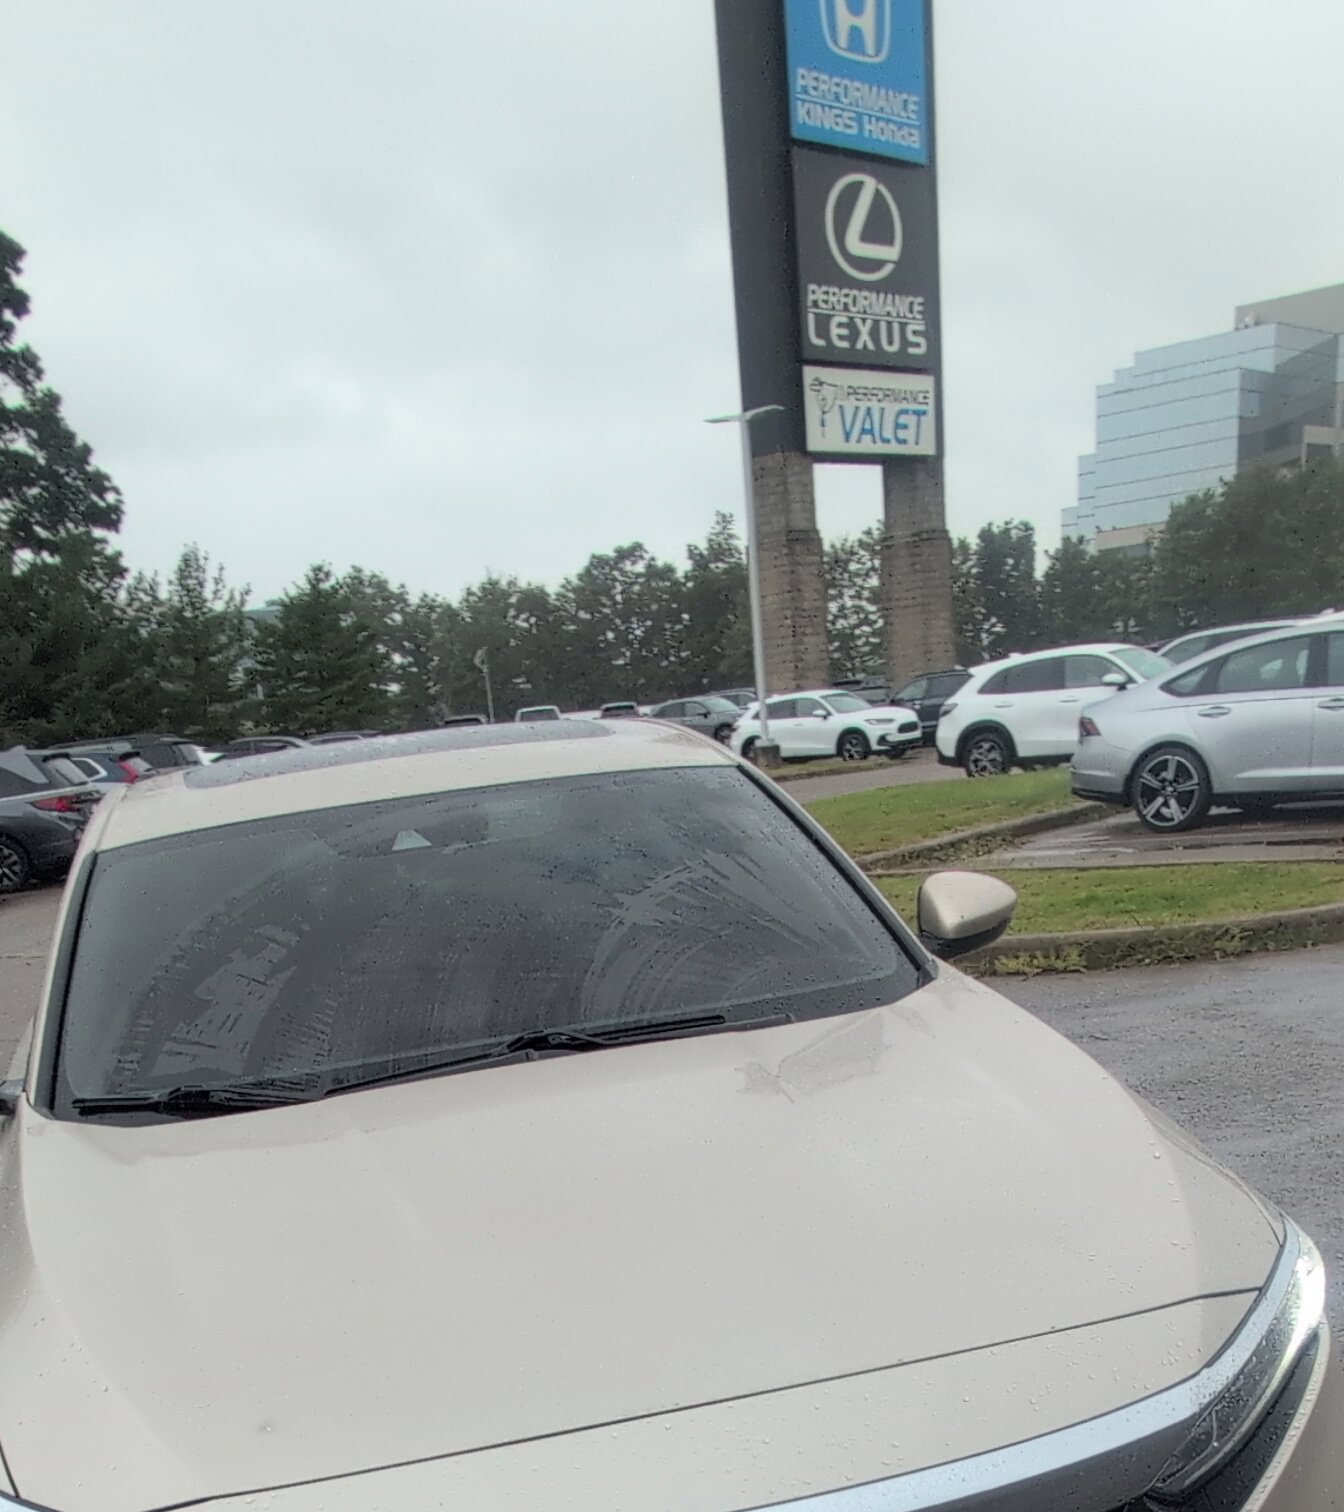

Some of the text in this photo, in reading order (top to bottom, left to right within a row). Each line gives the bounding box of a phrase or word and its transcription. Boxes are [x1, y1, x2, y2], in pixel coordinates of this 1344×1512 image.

[796, 68, 920, 120] PERFORMANCE
[796, 101, 858, 135] KINGS
[807, 283, 925, 319] PERFORMANCE
[807, 312, 928, 355] LEXUS
[846, 385, 930, 406] PERFORMANCE
[838, 405, 928, 446] VALET
